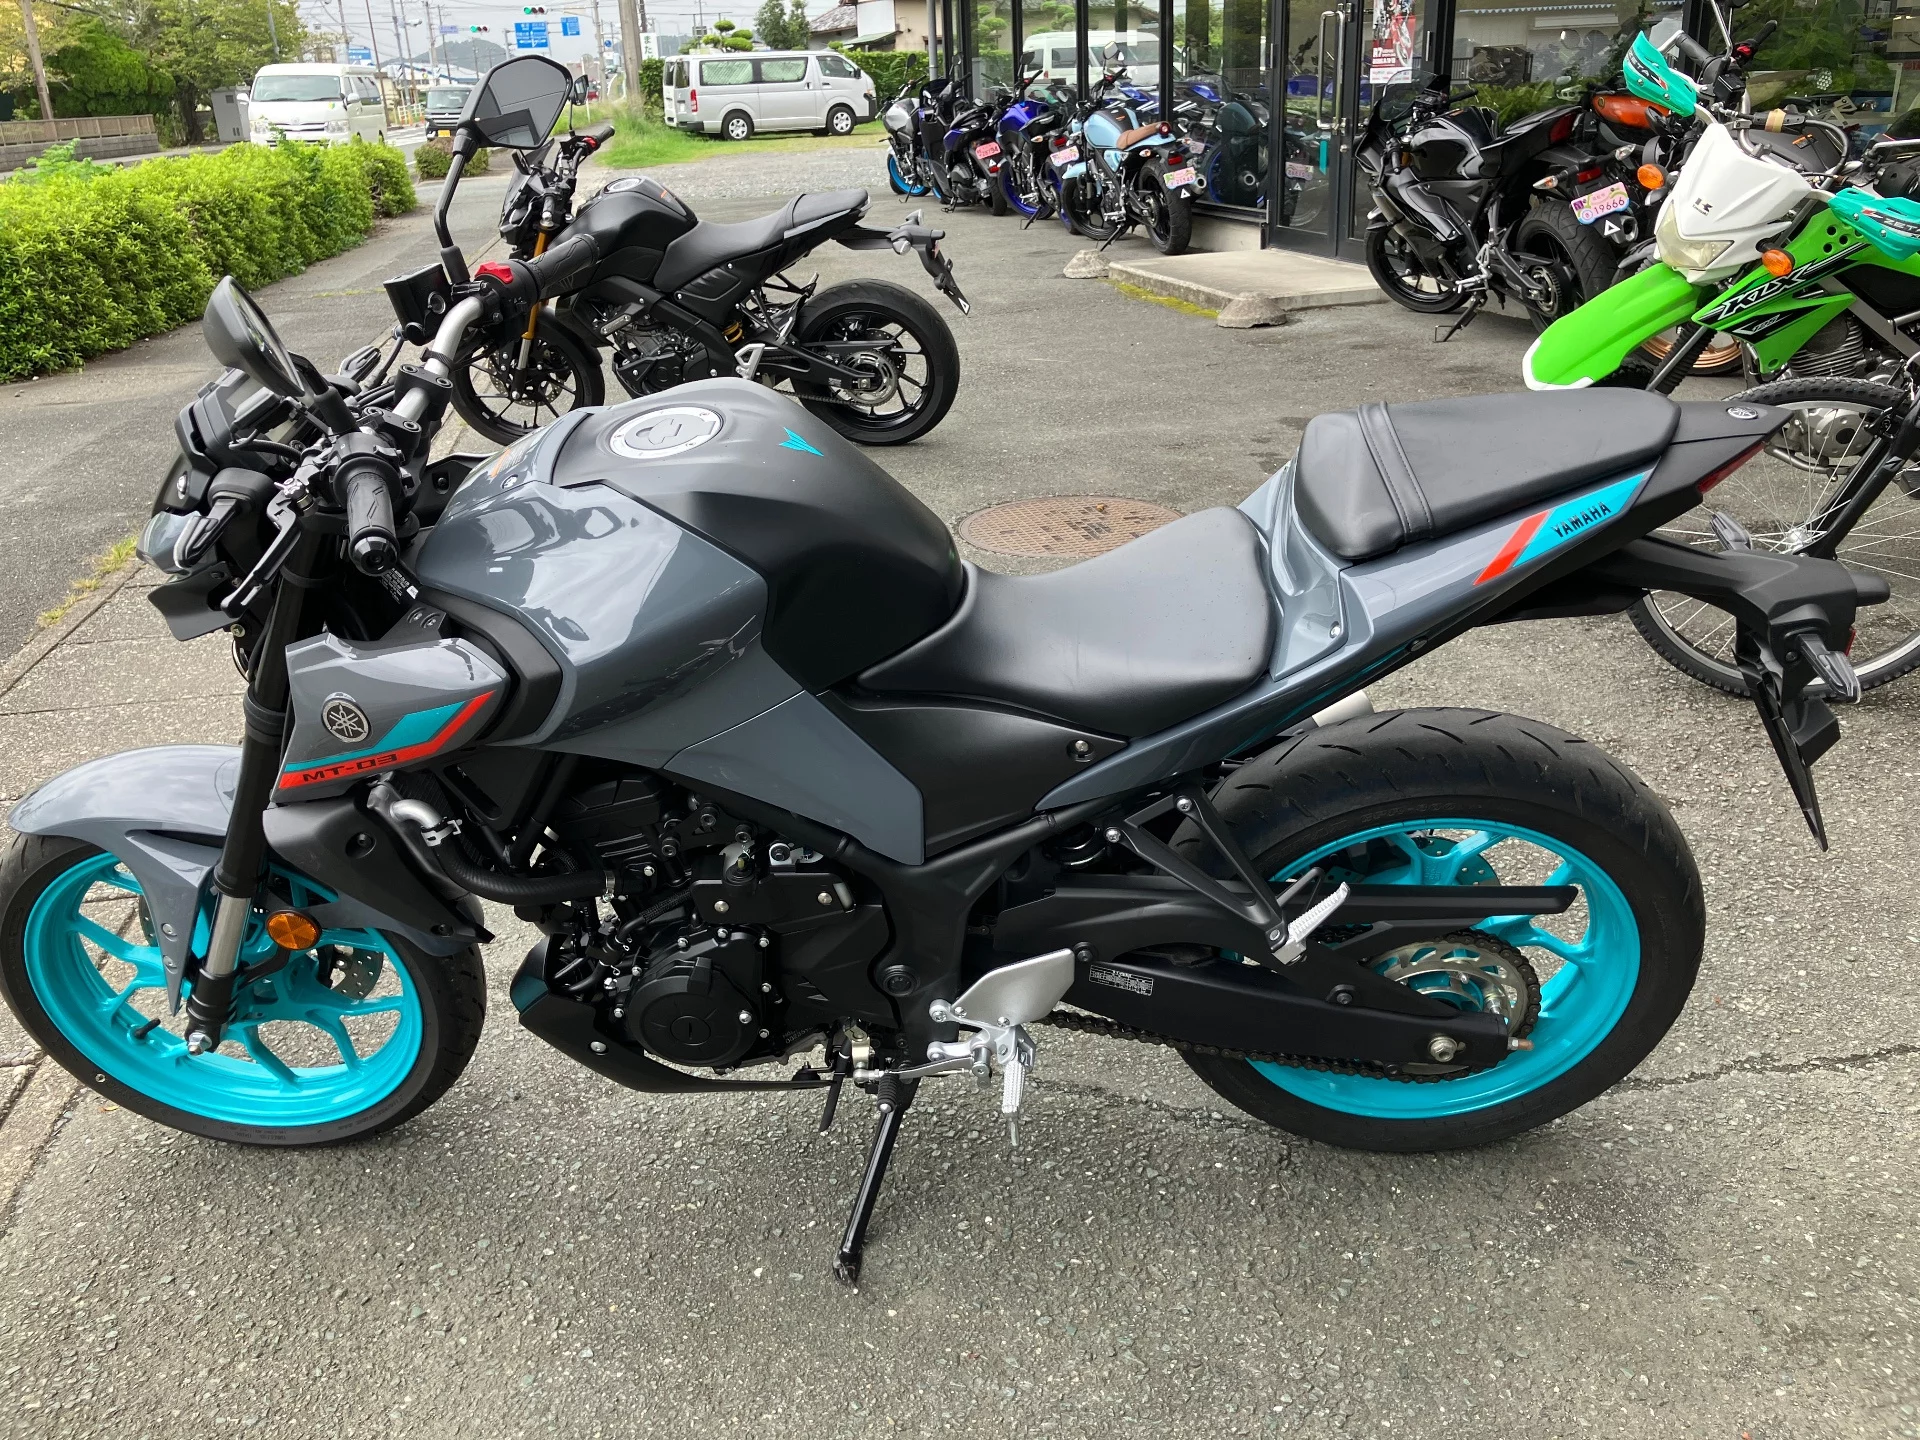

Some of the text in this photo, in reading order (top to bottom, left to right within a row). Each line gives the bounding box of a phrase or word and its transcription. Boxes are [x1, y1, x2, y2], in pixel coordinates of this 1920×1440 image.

[1594, 197, 1625, 215] 19666
[1551, 501, 1612, 538] YAMAHA
[303, 753, 399, 783] MT-03
